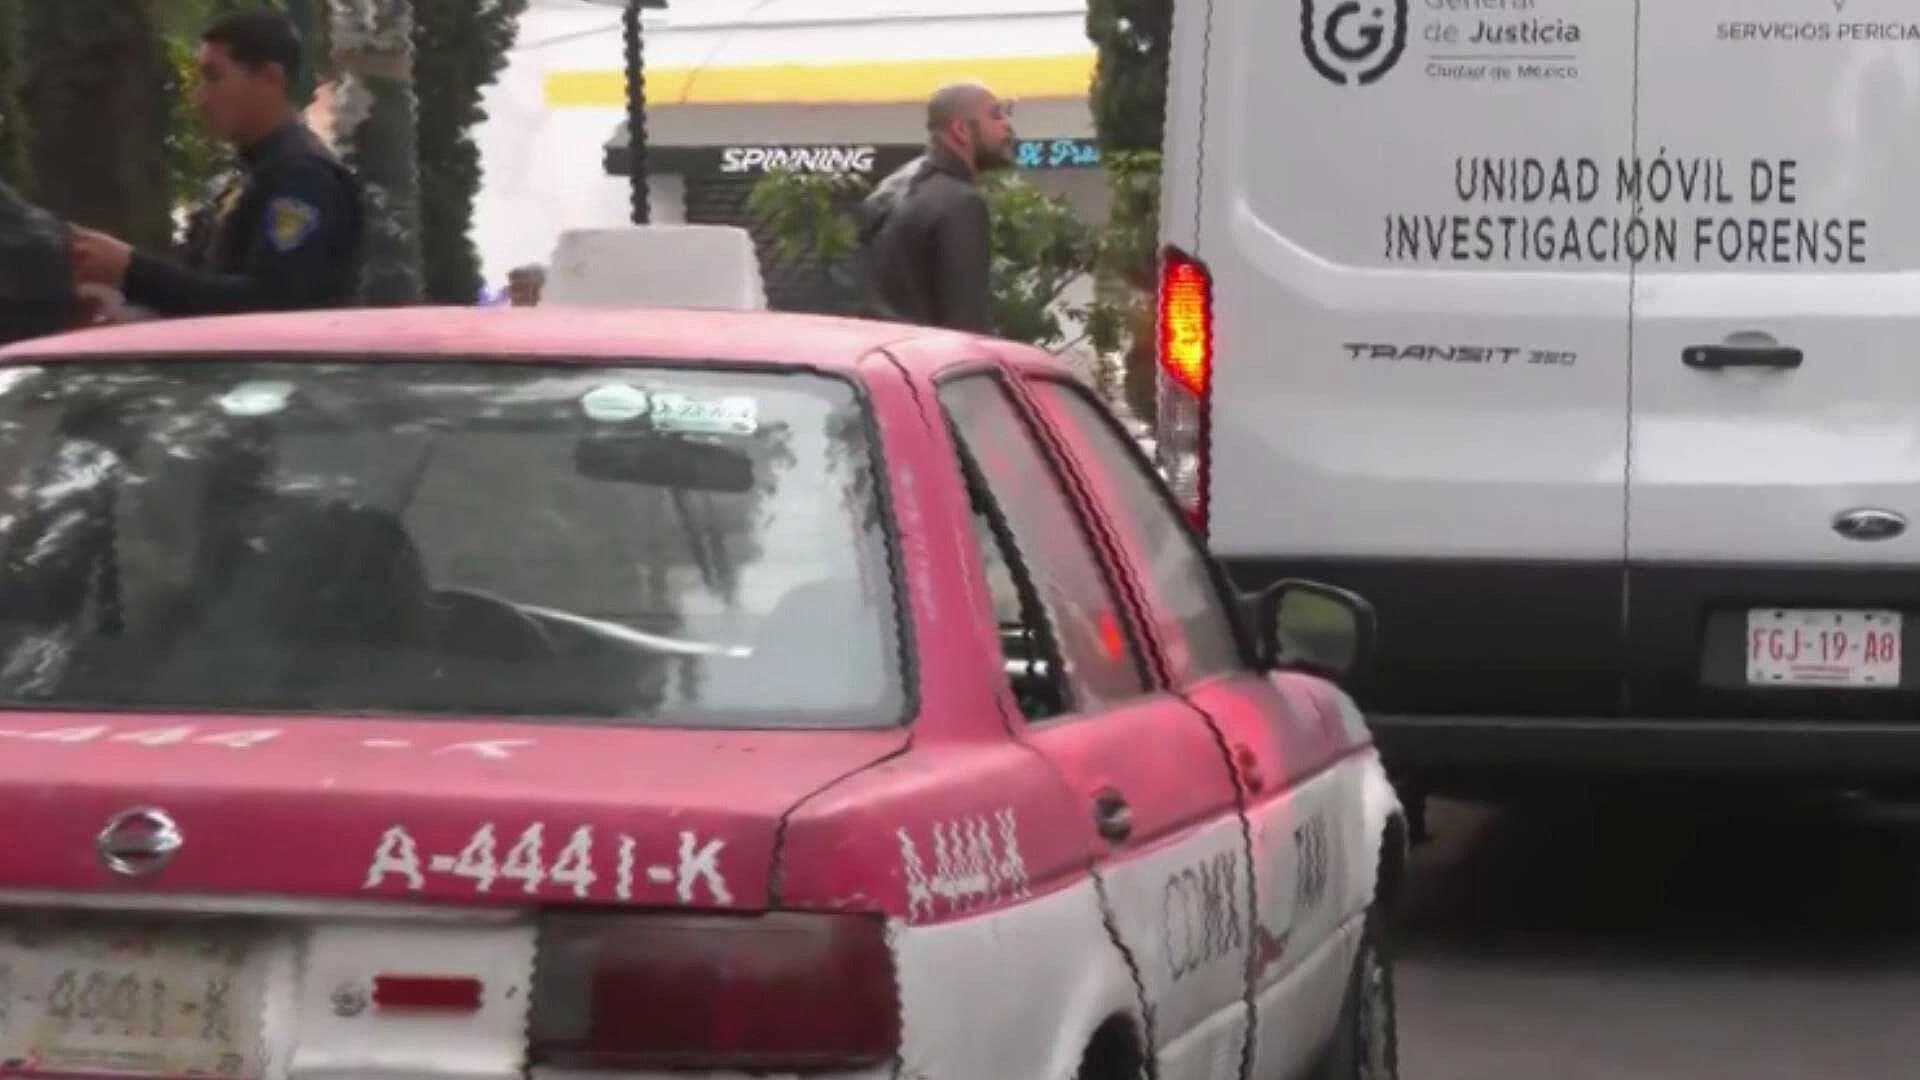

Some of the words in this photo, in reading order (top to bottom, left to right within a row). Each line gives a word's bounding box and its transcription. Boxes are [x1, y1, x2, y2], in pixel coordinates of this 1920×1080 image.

[1424, 20, 1458, 42] de
[1469, 18, 1581, 44] Justicia
[1717, 22, 1830, 40] SERVICIOS
[1424, 63, 1485, 79] Ciudad
[720, 146, 877, 173] SPINNING
[1455, 156, 1600, 203] UNIDAD
[1616, 145, 1734, 203] MÓVIL
[1751, 159, 1797, 203] DE
[1384, 205, 1677, 263] INVESTIGACIÓN
[1694, 216, 1867, 264] FORENSE
[1342, 342, 1522, 365] TRANSIT
[1752, 627, 1895, 664] FGJ-19-A8
[361, 821, 735, 905] A-4441-K
